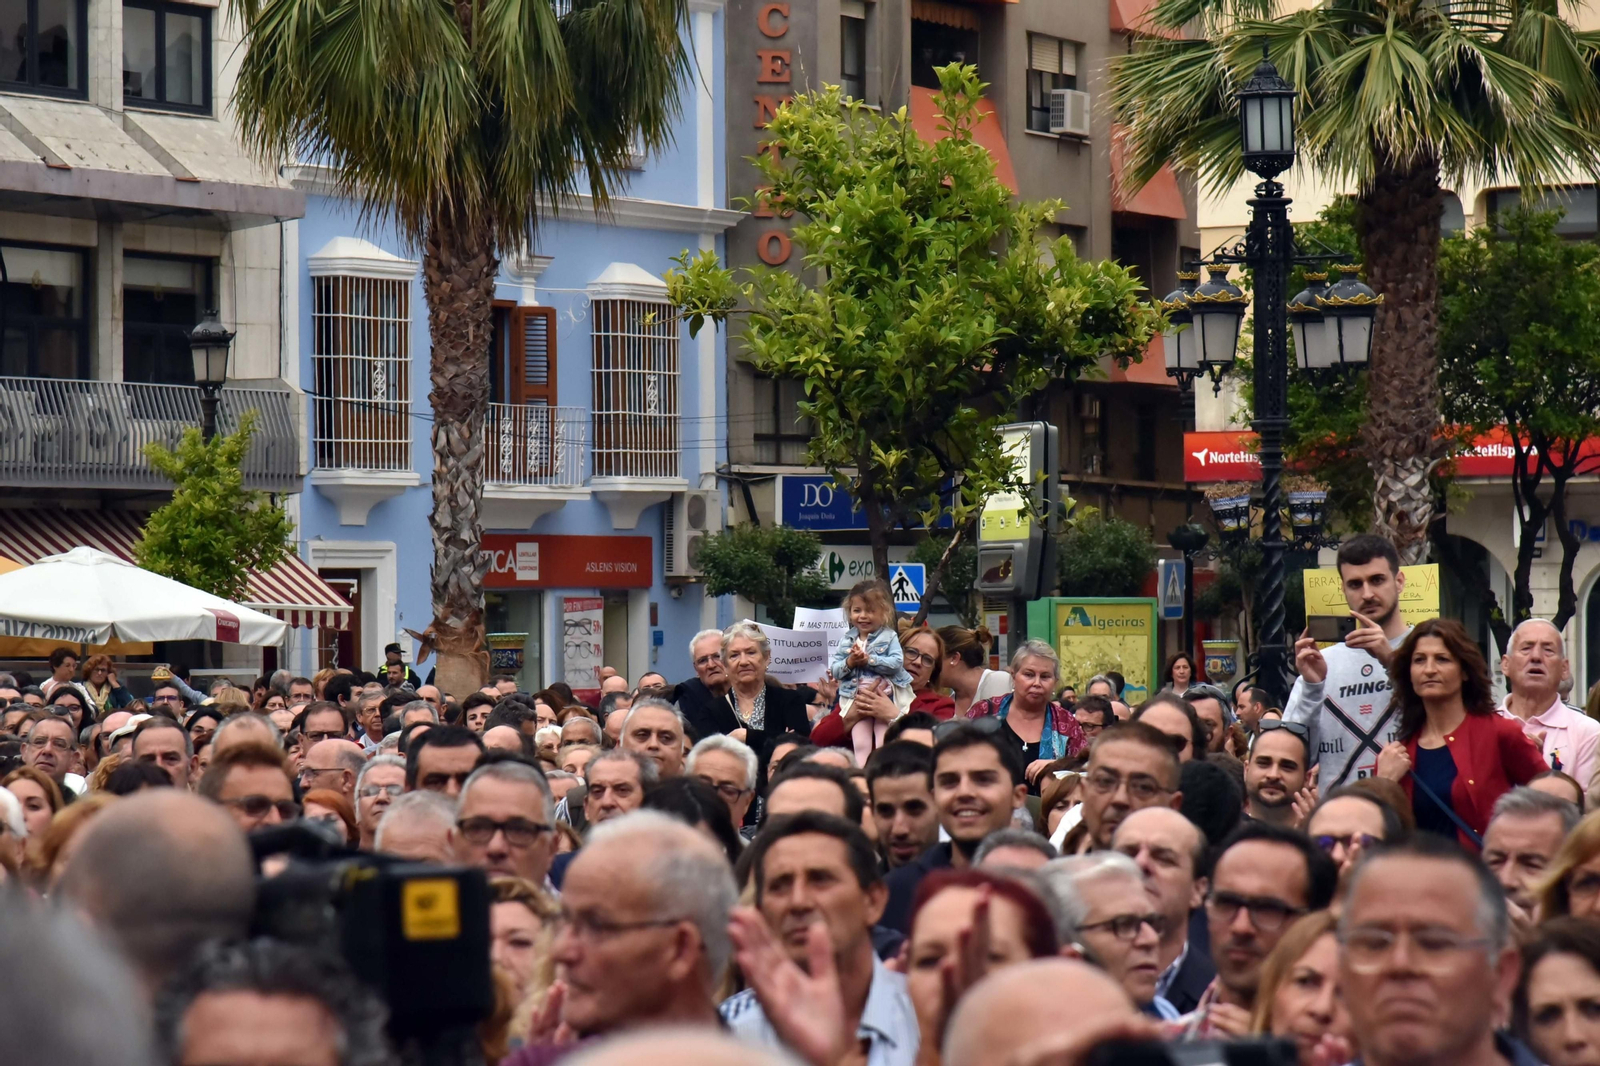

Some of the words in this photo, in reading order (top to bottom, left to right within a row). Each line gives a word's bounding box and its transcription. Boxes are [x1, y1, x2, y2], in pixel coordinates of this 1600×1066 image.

[585, 562, 613, 573] ASLENS
[614, 562, 638, 573] VISION
[1063, 606, 1145, 630] Algeciras
[773, 638, 822, 648] TITULADOS
[774, 655, 823, 665] CAMELLOS
